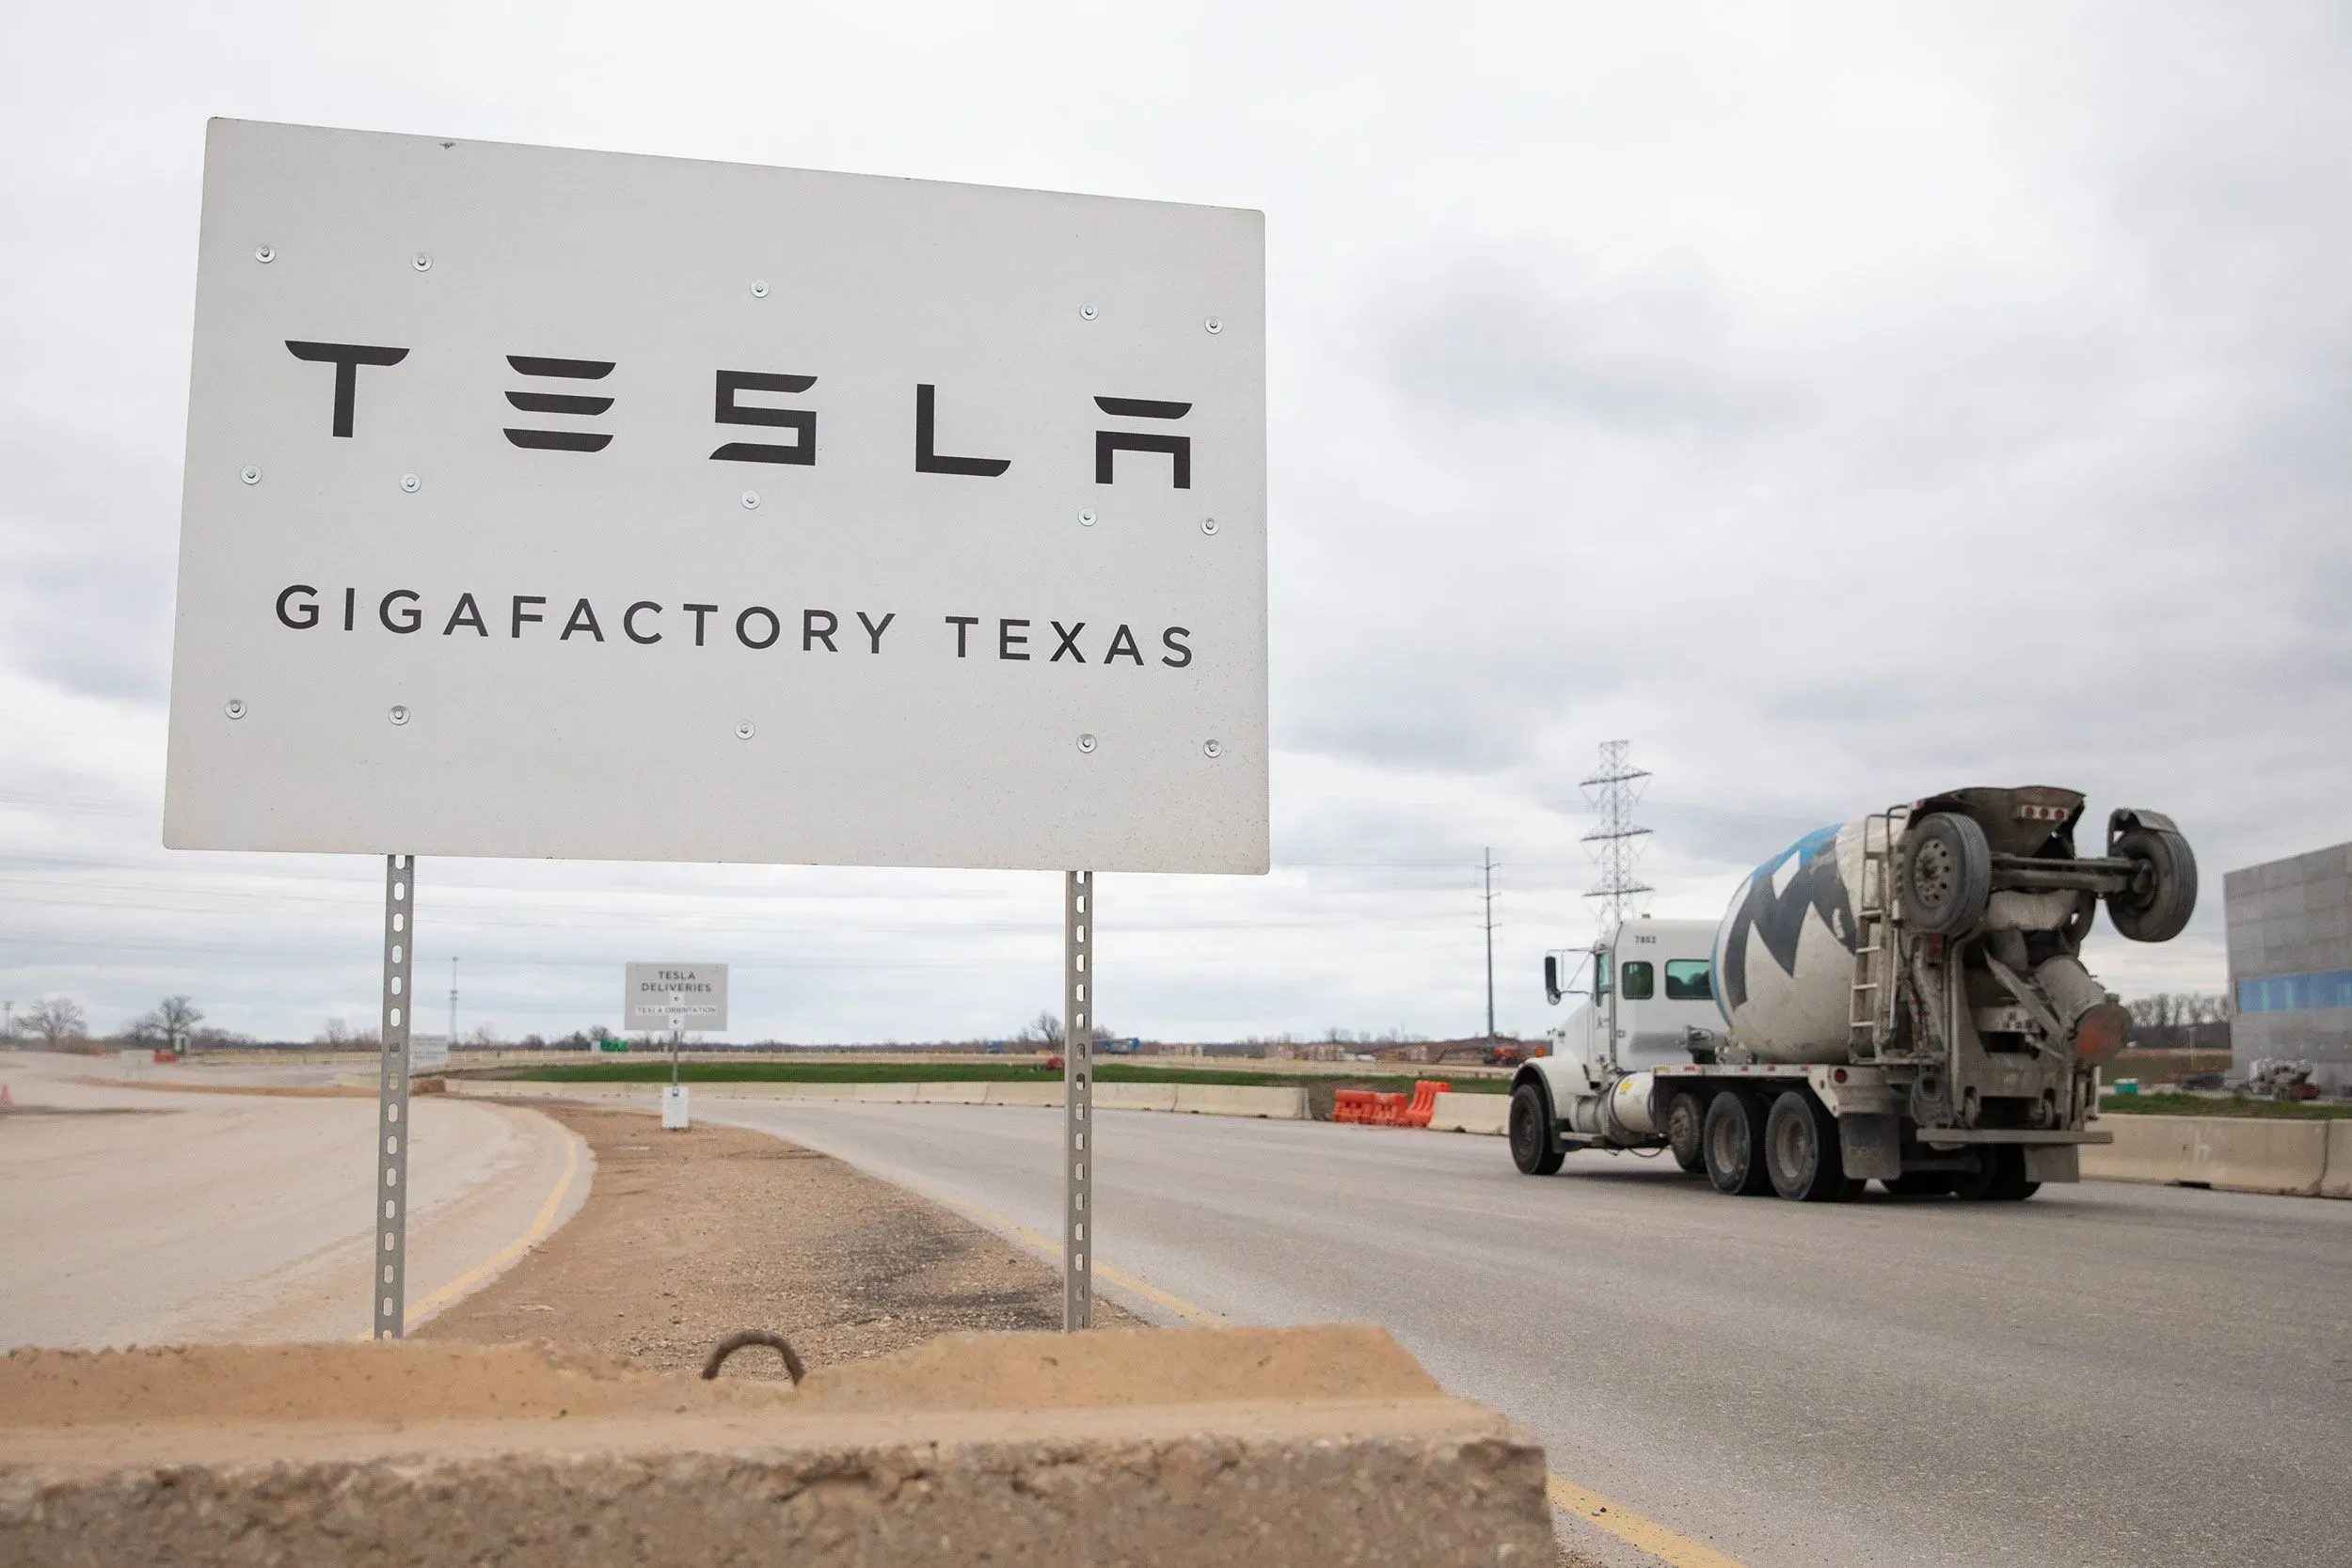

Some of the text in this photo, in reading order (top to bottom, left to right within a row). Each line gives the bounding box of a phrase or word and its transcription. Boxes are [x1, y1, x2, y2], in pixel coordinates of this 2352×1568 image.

[284, 340, 1193, 490] TESLA
[276, 584, 1192, 668] GIGAFACTORY TEXAS
[641, 982, 712, 992] DELIVERIES
[659, 971, 696, 980] TESLA
